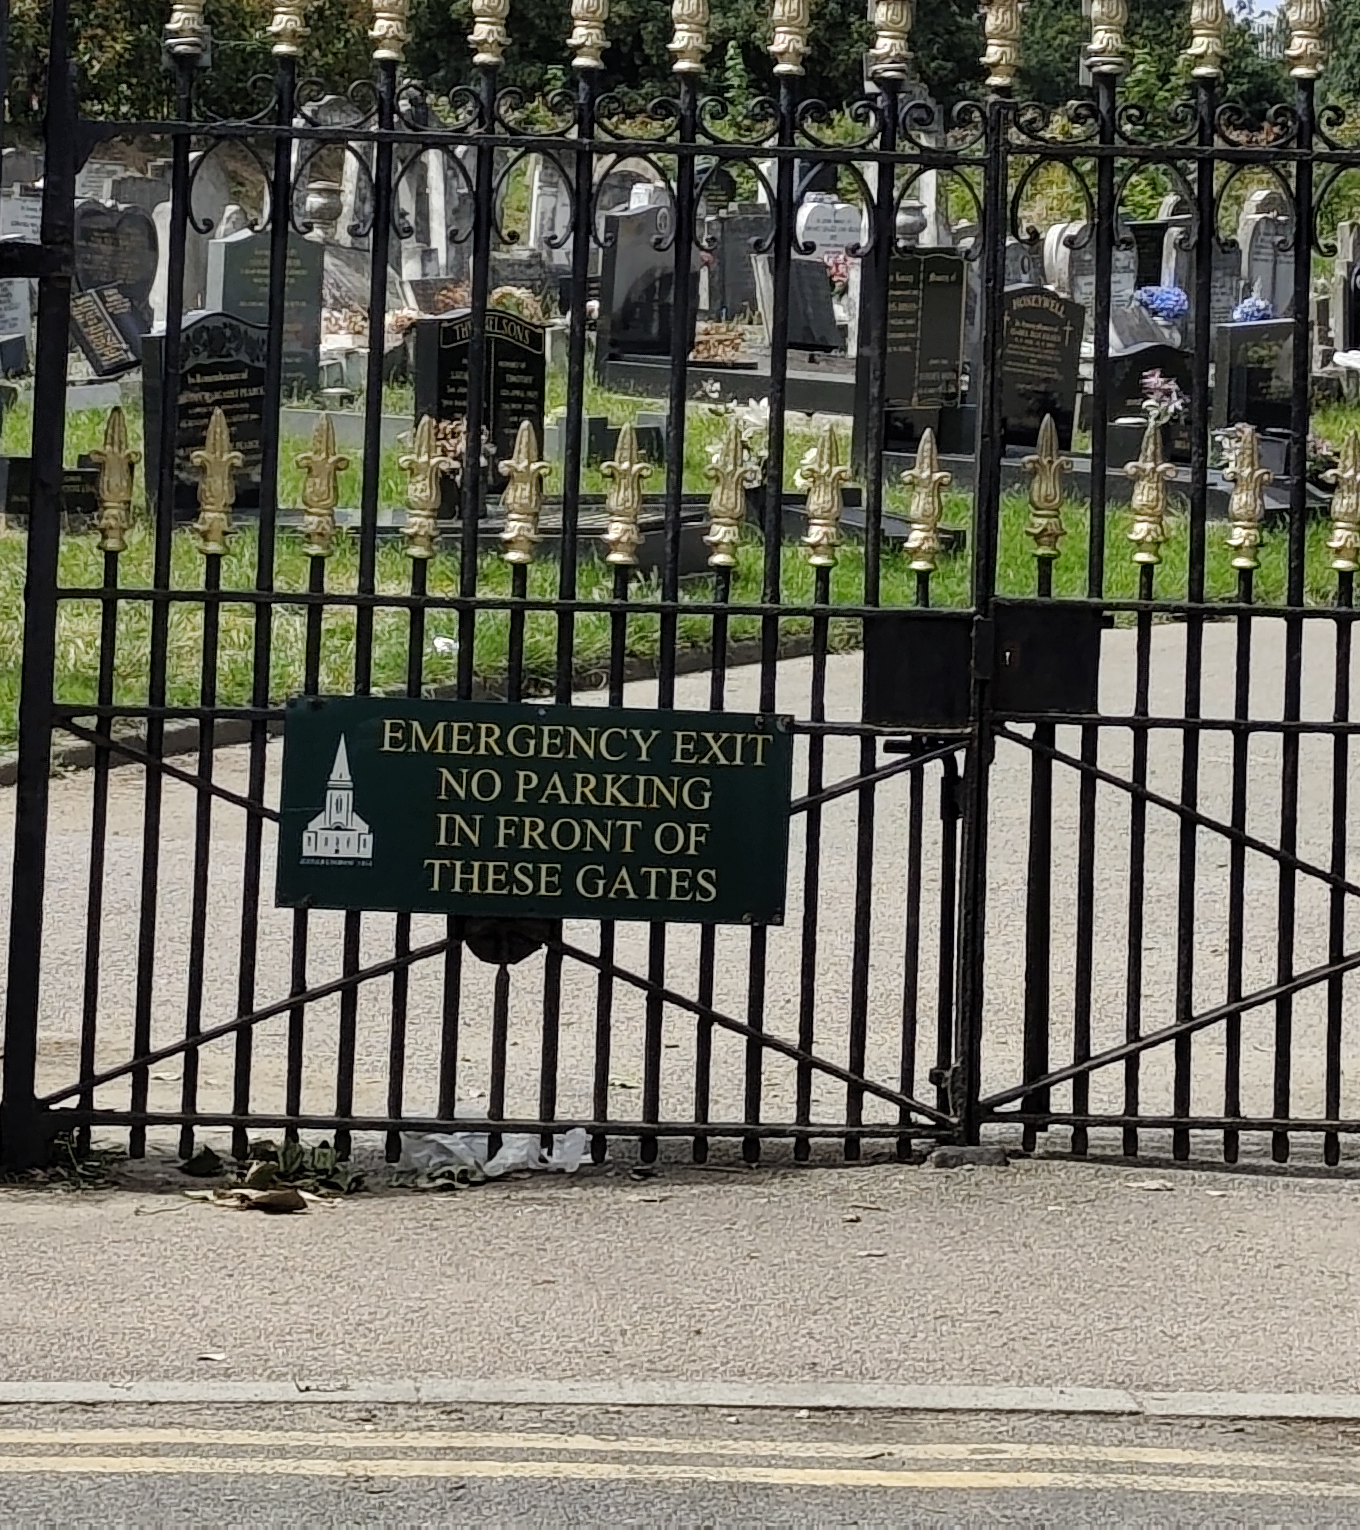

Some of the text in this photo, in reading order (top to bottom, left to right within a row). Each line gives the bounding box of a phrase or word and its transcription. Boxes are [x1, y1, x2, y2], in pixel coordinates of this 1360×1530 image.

[453, 319, 472, 341] TH
[380, 719, 774, 767] EMERGENCY EXIT
[436, 767, 712, 811] NO PARKING
[435, 813, 711, 856] IN FRONT OF
[423, 858, 718, 903] THESE GATES
